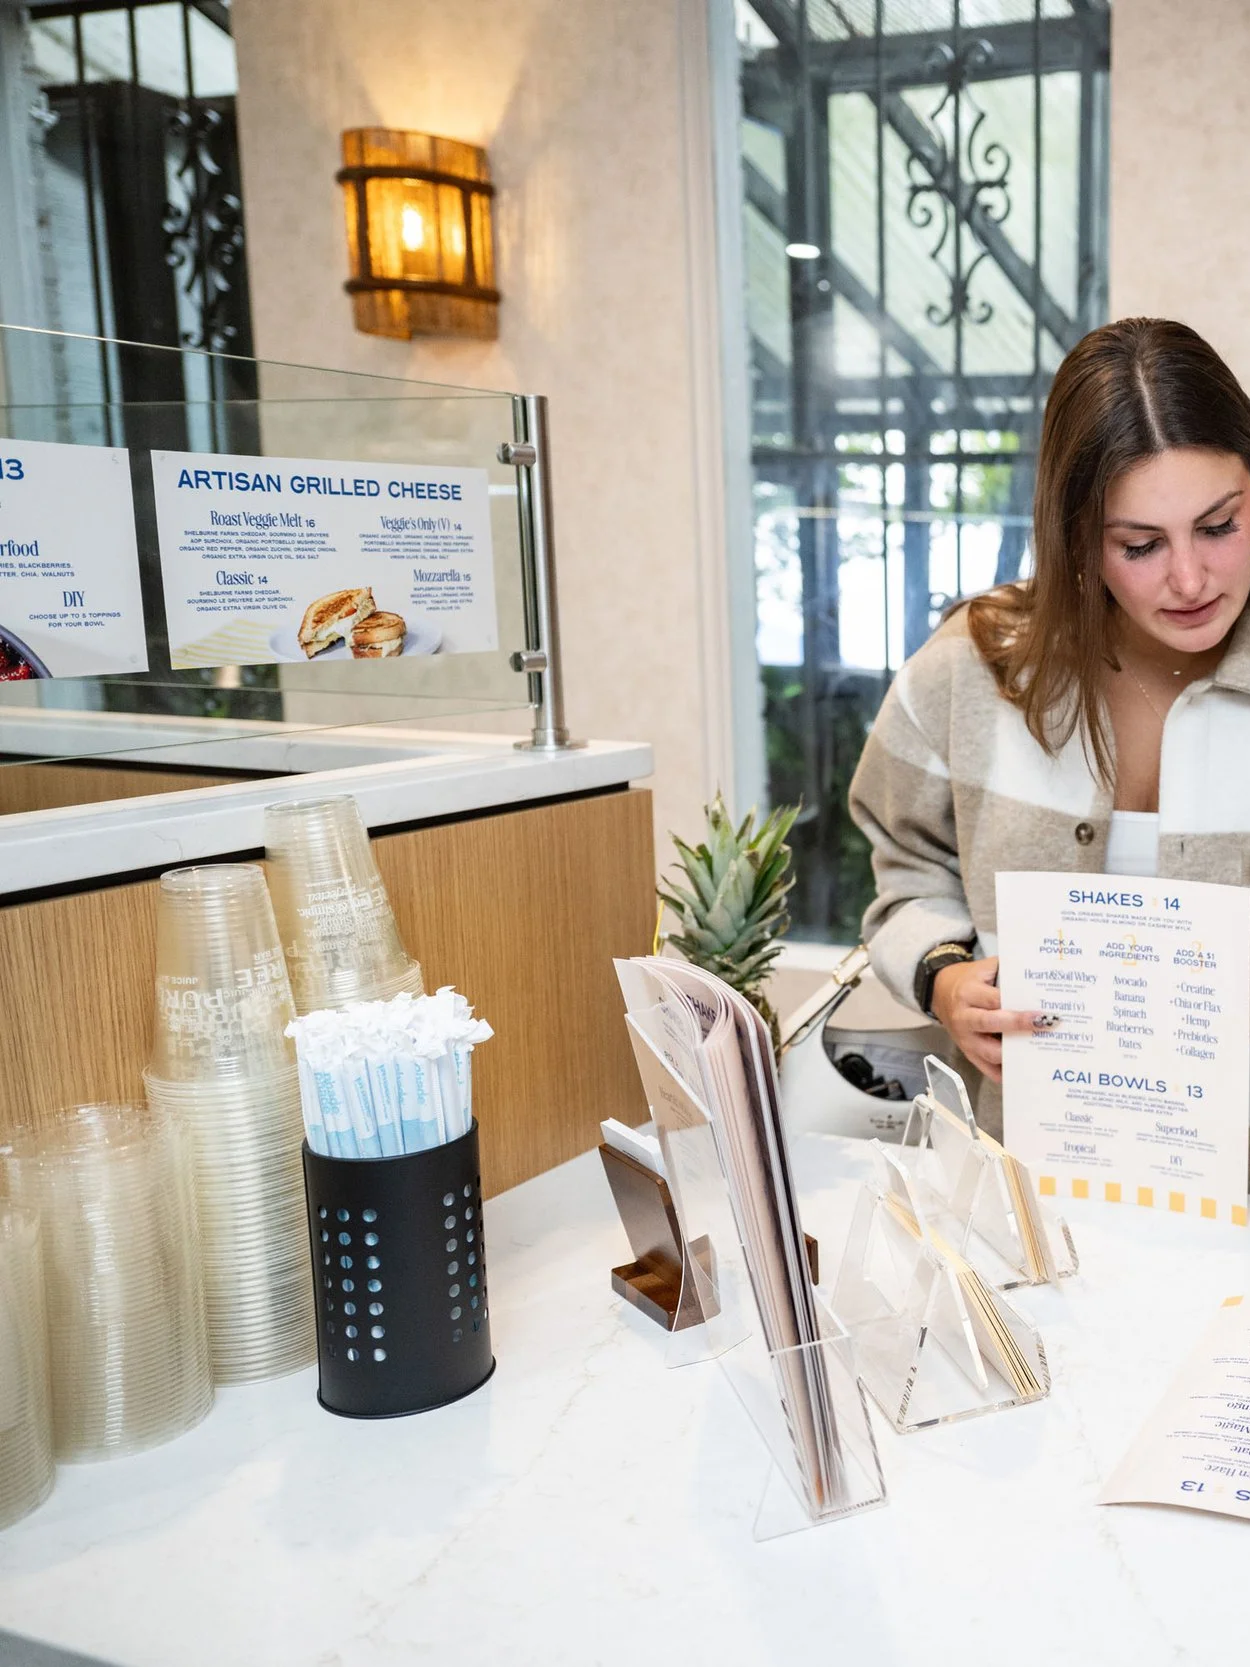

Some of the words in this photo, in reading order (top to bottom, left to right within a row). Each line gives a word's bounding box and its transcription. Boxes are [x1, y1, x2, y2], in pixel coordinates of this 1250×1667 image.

[178, 469, 282, 493] ARTISAN
[290, 475, 380, 497] GRILLED
[388, 481, 462, 501] CHEESE
[210, 510, 242, 527] Roast
[242, 511, 278, 530] Veggie
[279, 513, 302, 528] Melt
[305, 519, 316, 528] 16
[380, 515, 416, 532] Veggie's
[417, 516, 436, 532] Only
[437, 517, 450, 531] (V)
[216, 570, 254, 585] Classic
[258, 576, 268, 585] 14
[413, 568, 460, 582] Mozzarella
[63, 591, 85, 607] DIY
[1068, 890, 1143, 907] SHAKES
[1163, 897, 1181, 911] 14
[1043, 938, 1065, 946] PICK
[1106, 942, 1125, 951] ADD
[1129, 943, 1153, 953] YOUR
[1039, 946, 1083, 955] POWDER
[1099, 950, 1160, 963] INGREDIENTS
[1176, 949, 1195, 957] ADD
[1173, 957, 1217, 969] BOOSTER
[1074, 971, 1097, 985] Whey
[1112, 976, 1147, 988] Avocado
[1114, 991, 1145, 1003] Banana
[1040, 999, 1073, 1010] Truvani
[1193, 1002, 1202, 1011] or
[1203, 1001, 1222, 1013] Flax
[1113, 1006, 1147, 1020] Spinach
[1031, 1029, 1081, 1041] Sunwarrior
[1106, 1021, 1154, 1036] Blueberries
[1118, 1037, 1142, 1050] Dates
[1052, 1069, 1091, 1085] ACAI
[1099, 1073, 1167, 1093] BOWLS
[1186, 1085, 1203, 1098] 13
[1065, 1111, 1093, 1124] Classic
[1155, 1120, 1198, 1138] Superfood
[1063, 1141, 1096, 1154] Tropical
[1215, 1420, 1250, 1434] Magic
[1204, 1463, 1236, 1477] Haze
[1180, 1481, 1205, 1493] 13
